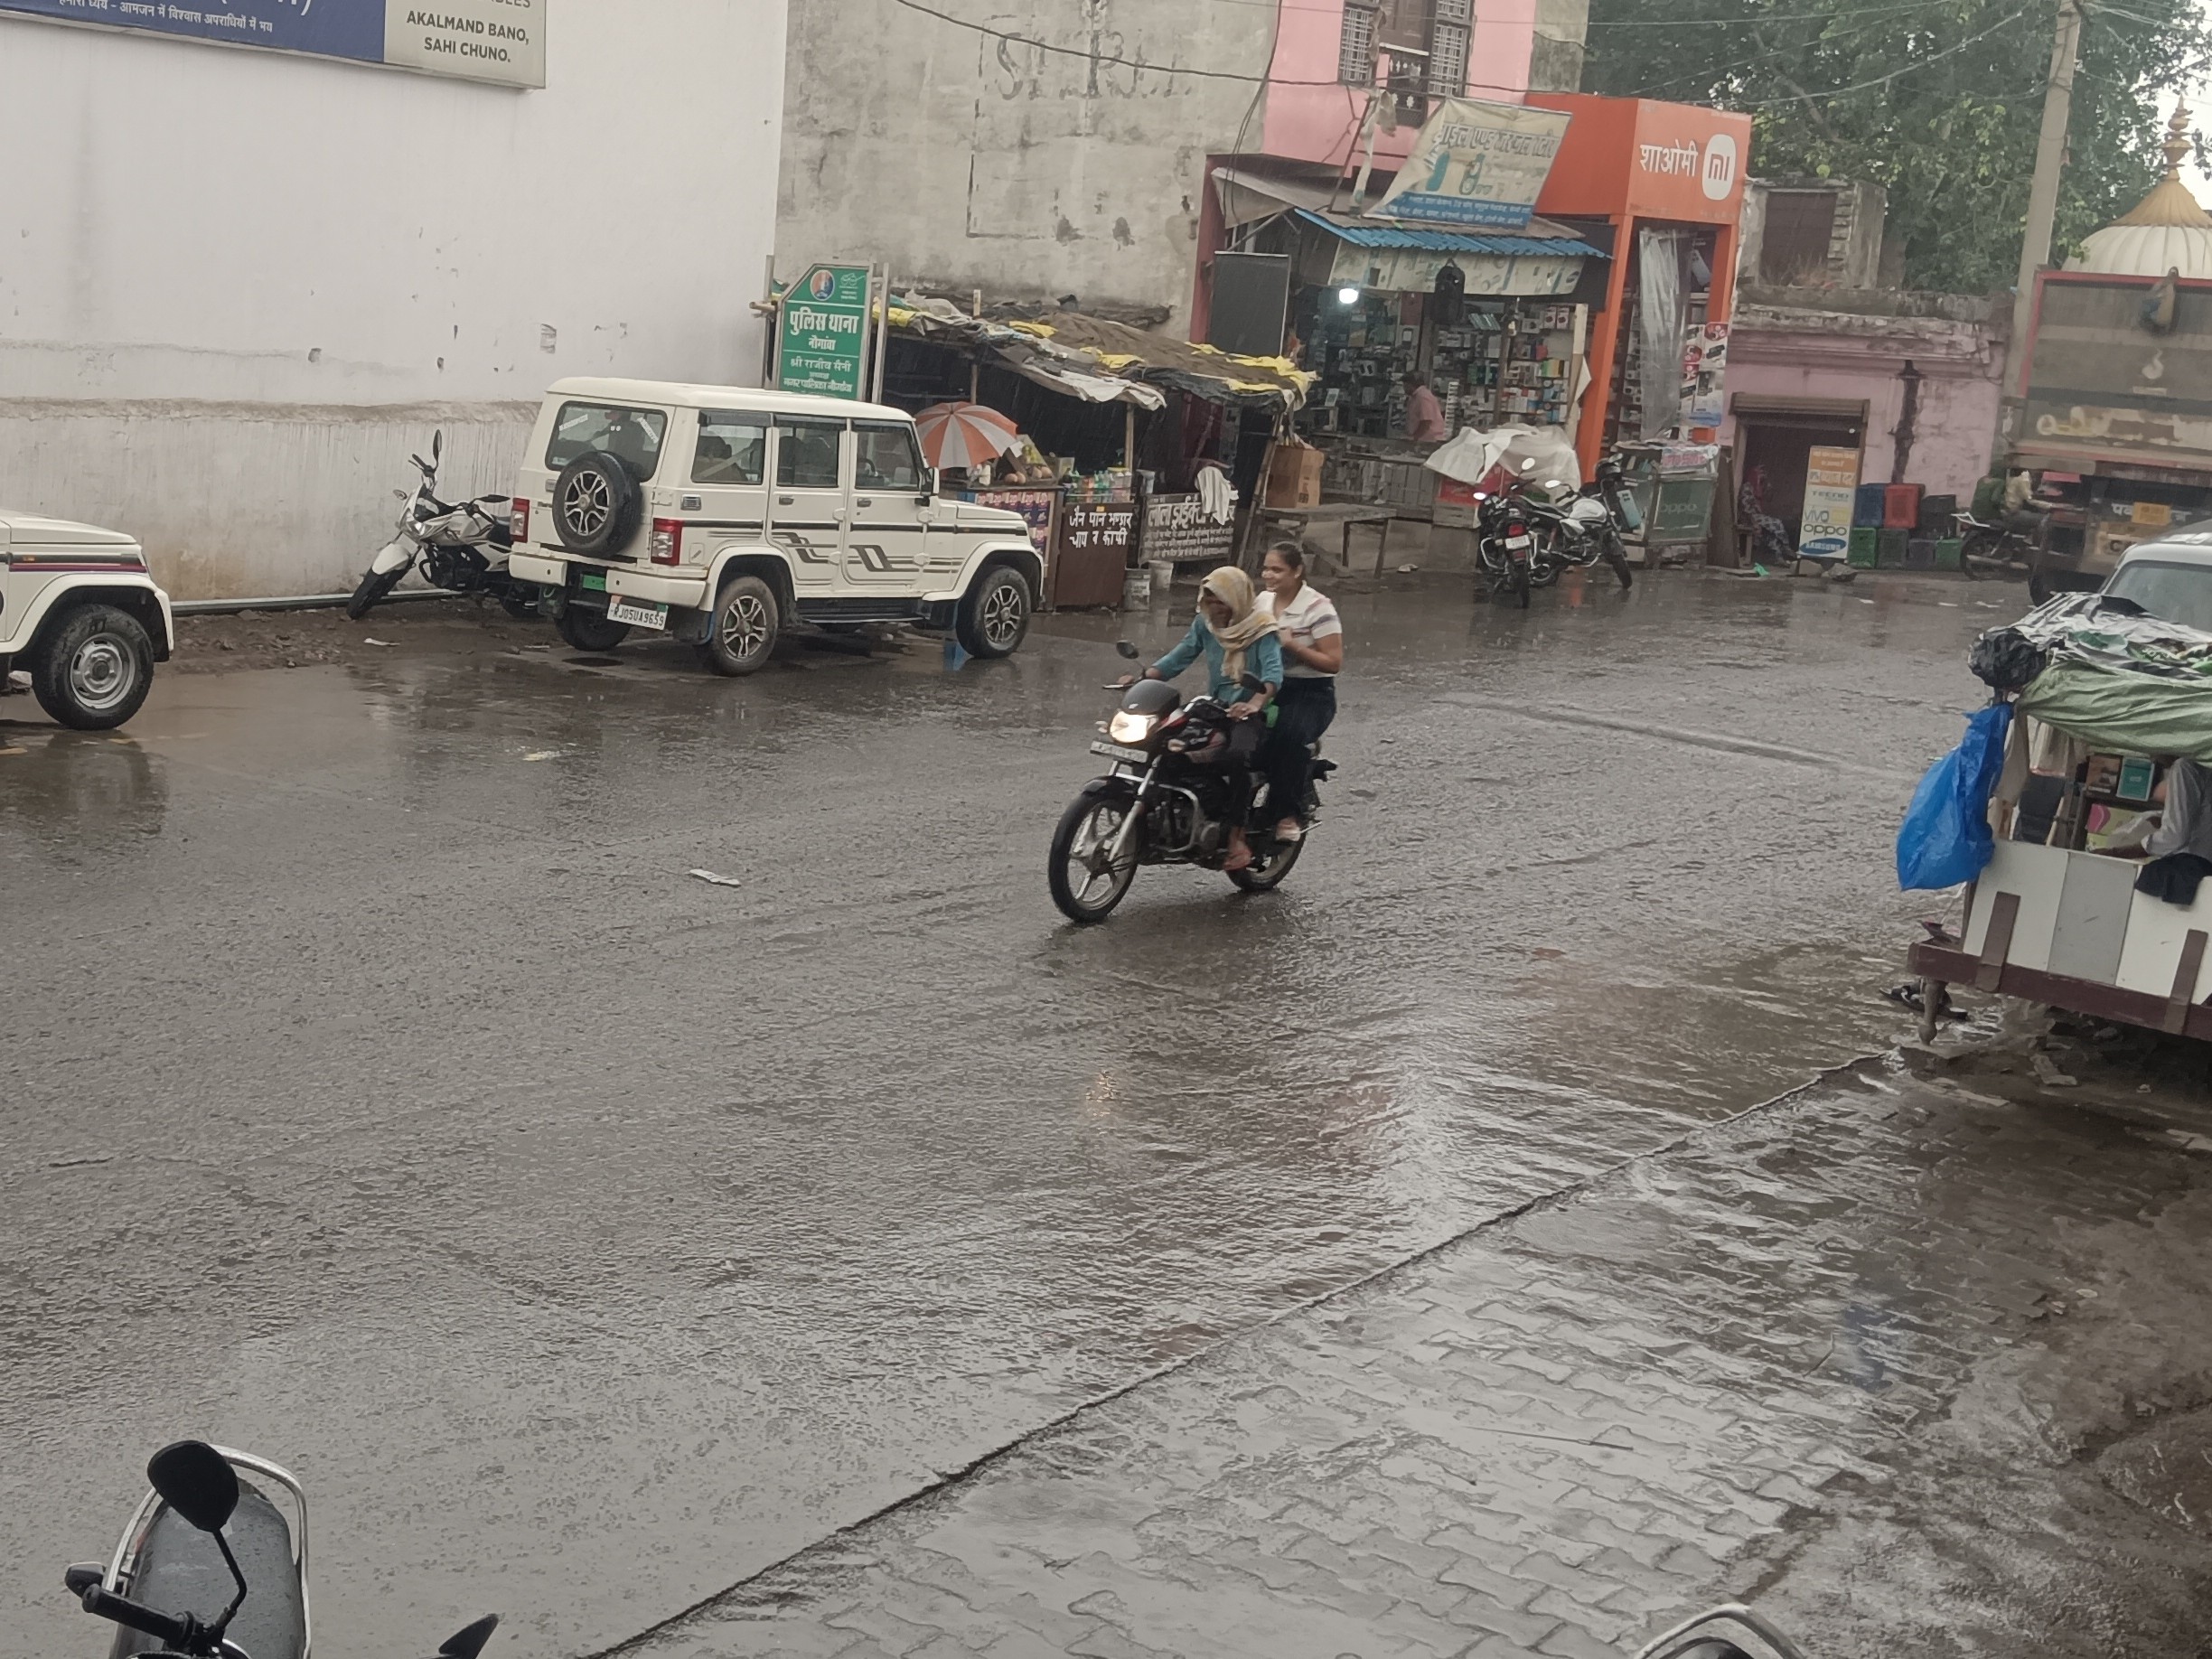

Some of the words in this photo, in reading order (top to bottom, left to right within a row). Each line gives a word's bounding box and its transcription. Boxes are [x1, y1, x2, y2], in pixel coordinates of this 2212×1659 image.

[119, 3, 155, 17] आमजन
[157, 4, 166, 17] में
[203, 12, 247, 30] अपराधियों
[248, 15, 257, 31] में
[407, 10, 484, 34] AKALMAND
[488, 23, 530, 44] BANO,
[424, 36, 456, 54] SAHI
[460, 42, 511, 62] CHUNO.
[1639, 138, 1698, 177] शाओमी
[790, 306, 827, 335] पुलिस
[829, 314, 858, 333] थाना
[791, 356, 802, 368] श्री
[1069, 505, 1085, 527] जैन
[1089, 512, 1106, 527] पान
[1804, 524, 1847, 536] oppo
